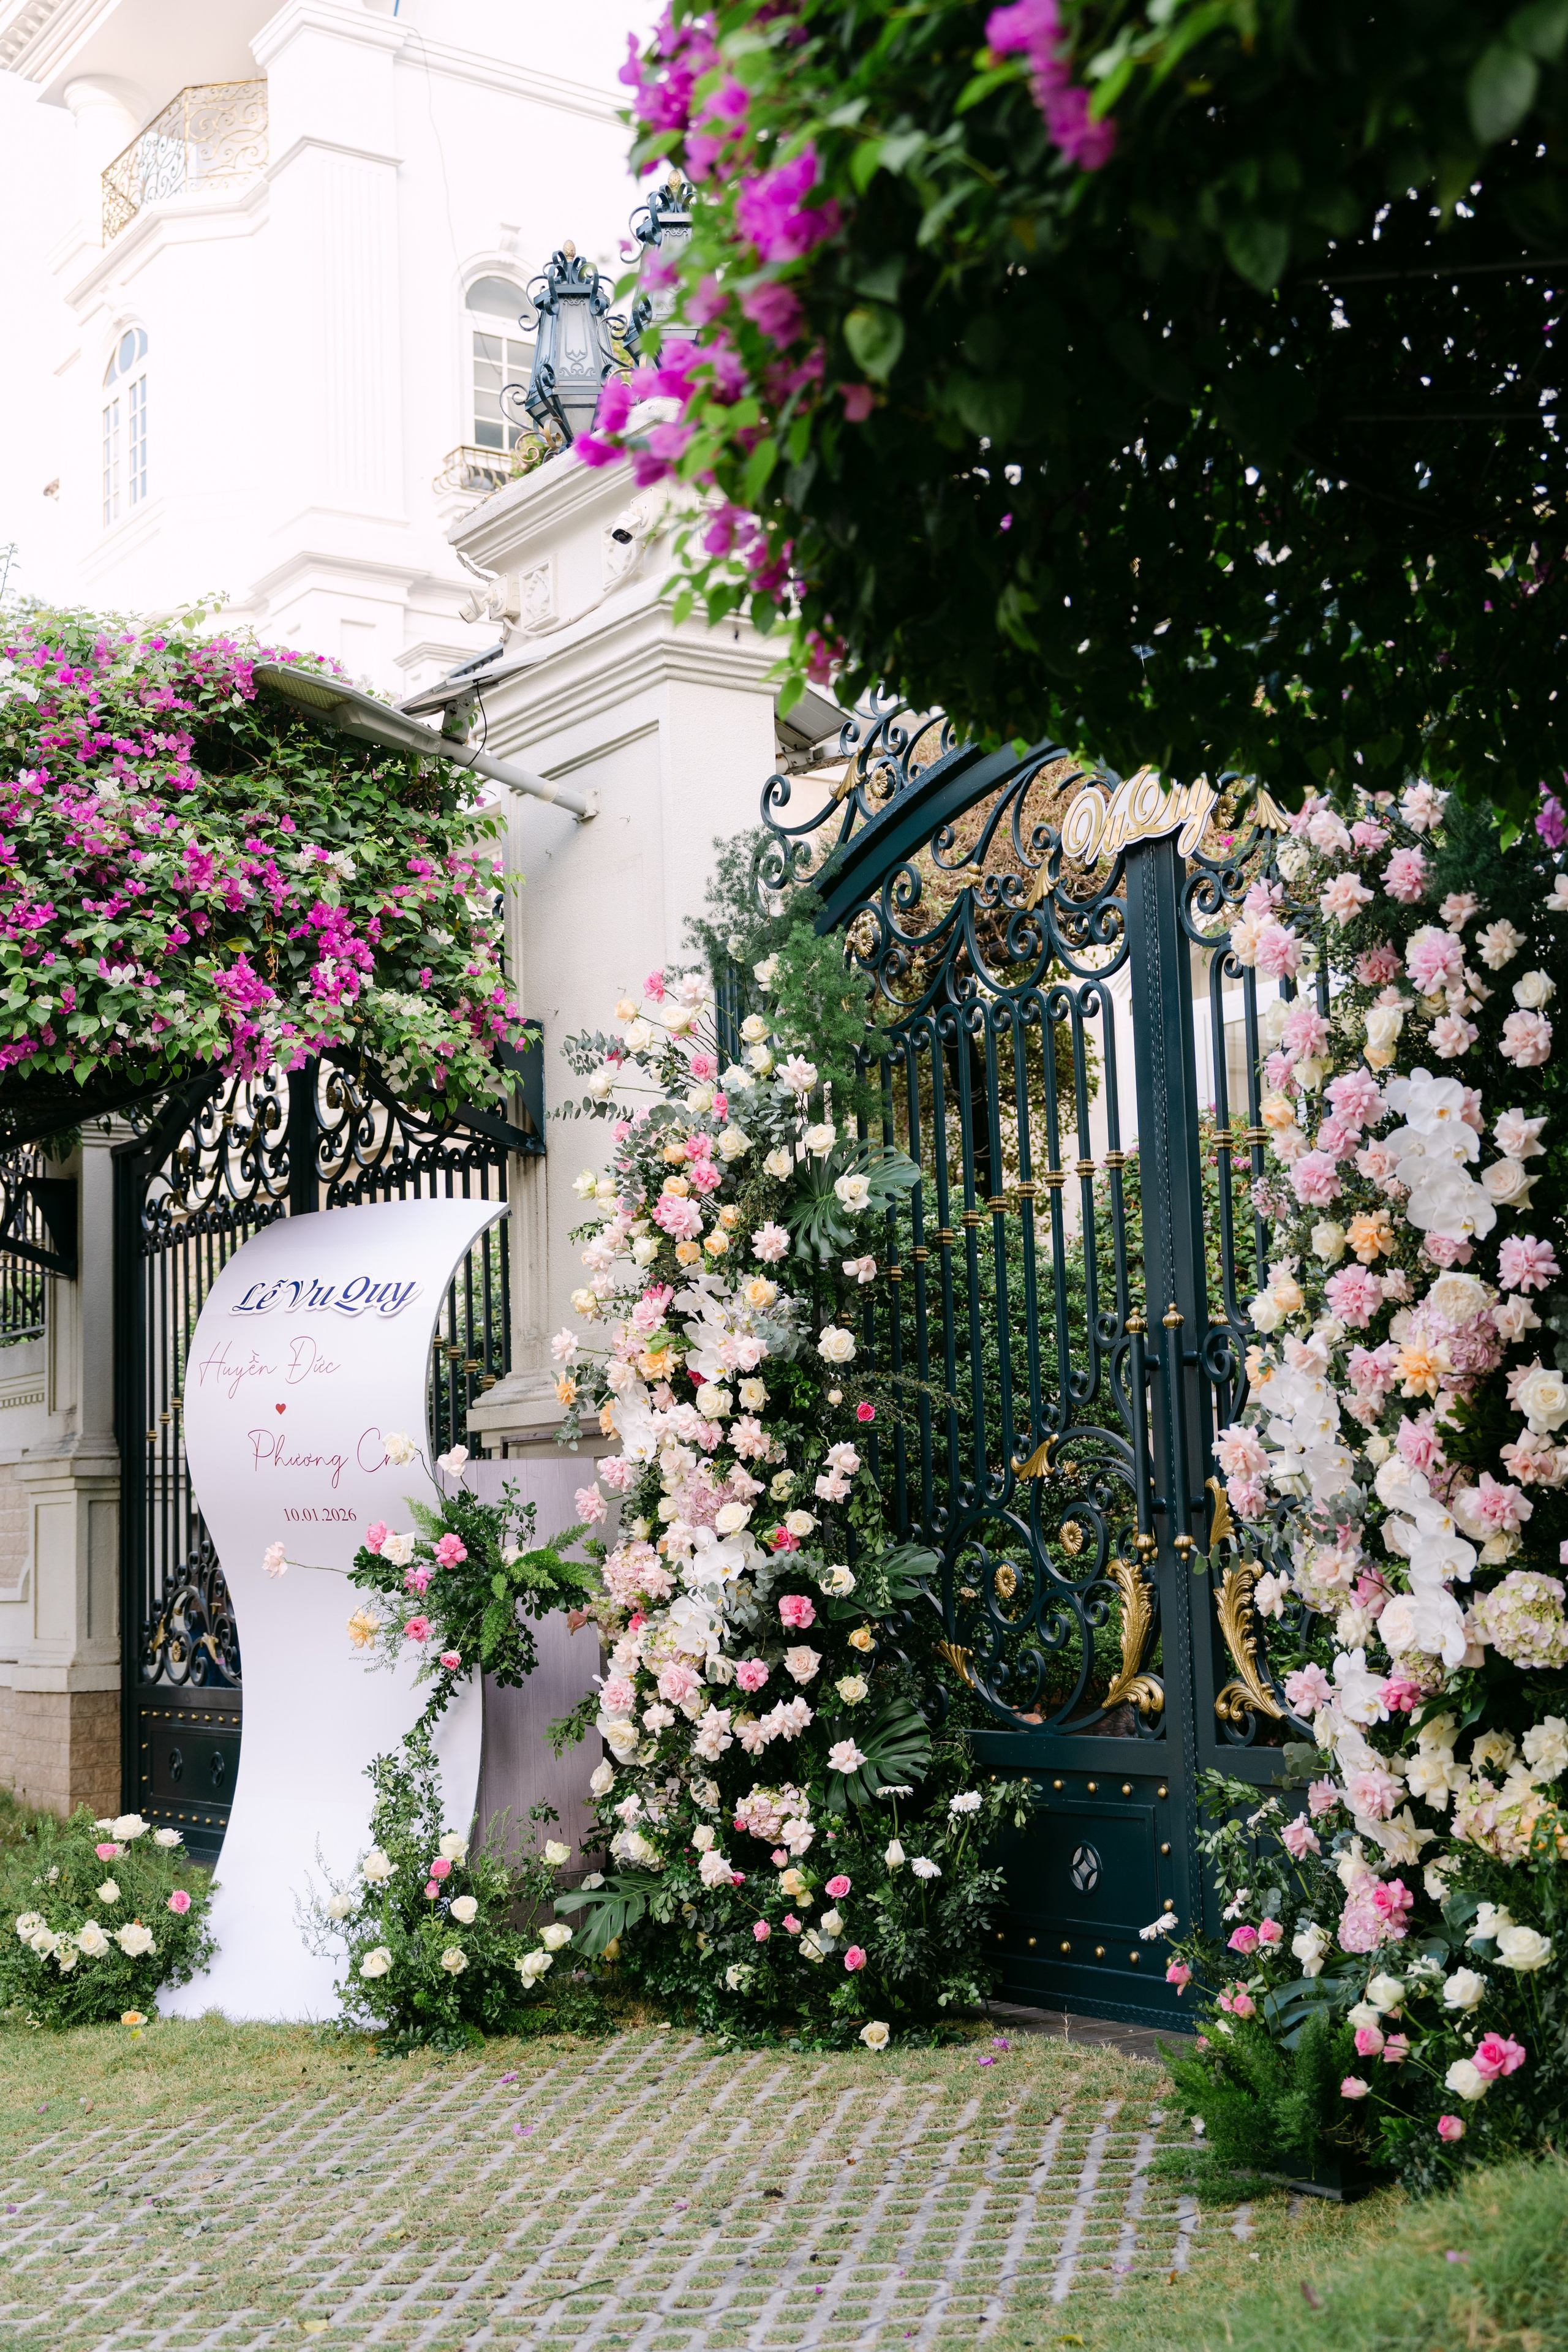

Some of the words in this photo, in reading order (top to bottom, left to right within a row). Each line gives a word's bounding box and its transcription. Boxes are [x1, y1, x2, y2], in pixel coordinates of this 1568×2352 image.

[232, 1278, 289, 1312] Lễ
[286, 1278, 336, 1308] Vu
[333, 1276, 417, 1313] Quy
[199, 1340, 277, 1399] Huyền
[285, 1336, 341, 1384] Đức
[247, 1429, 349, 1489] Phương
[283, 1508, 357, 1521] 10.01.2026
